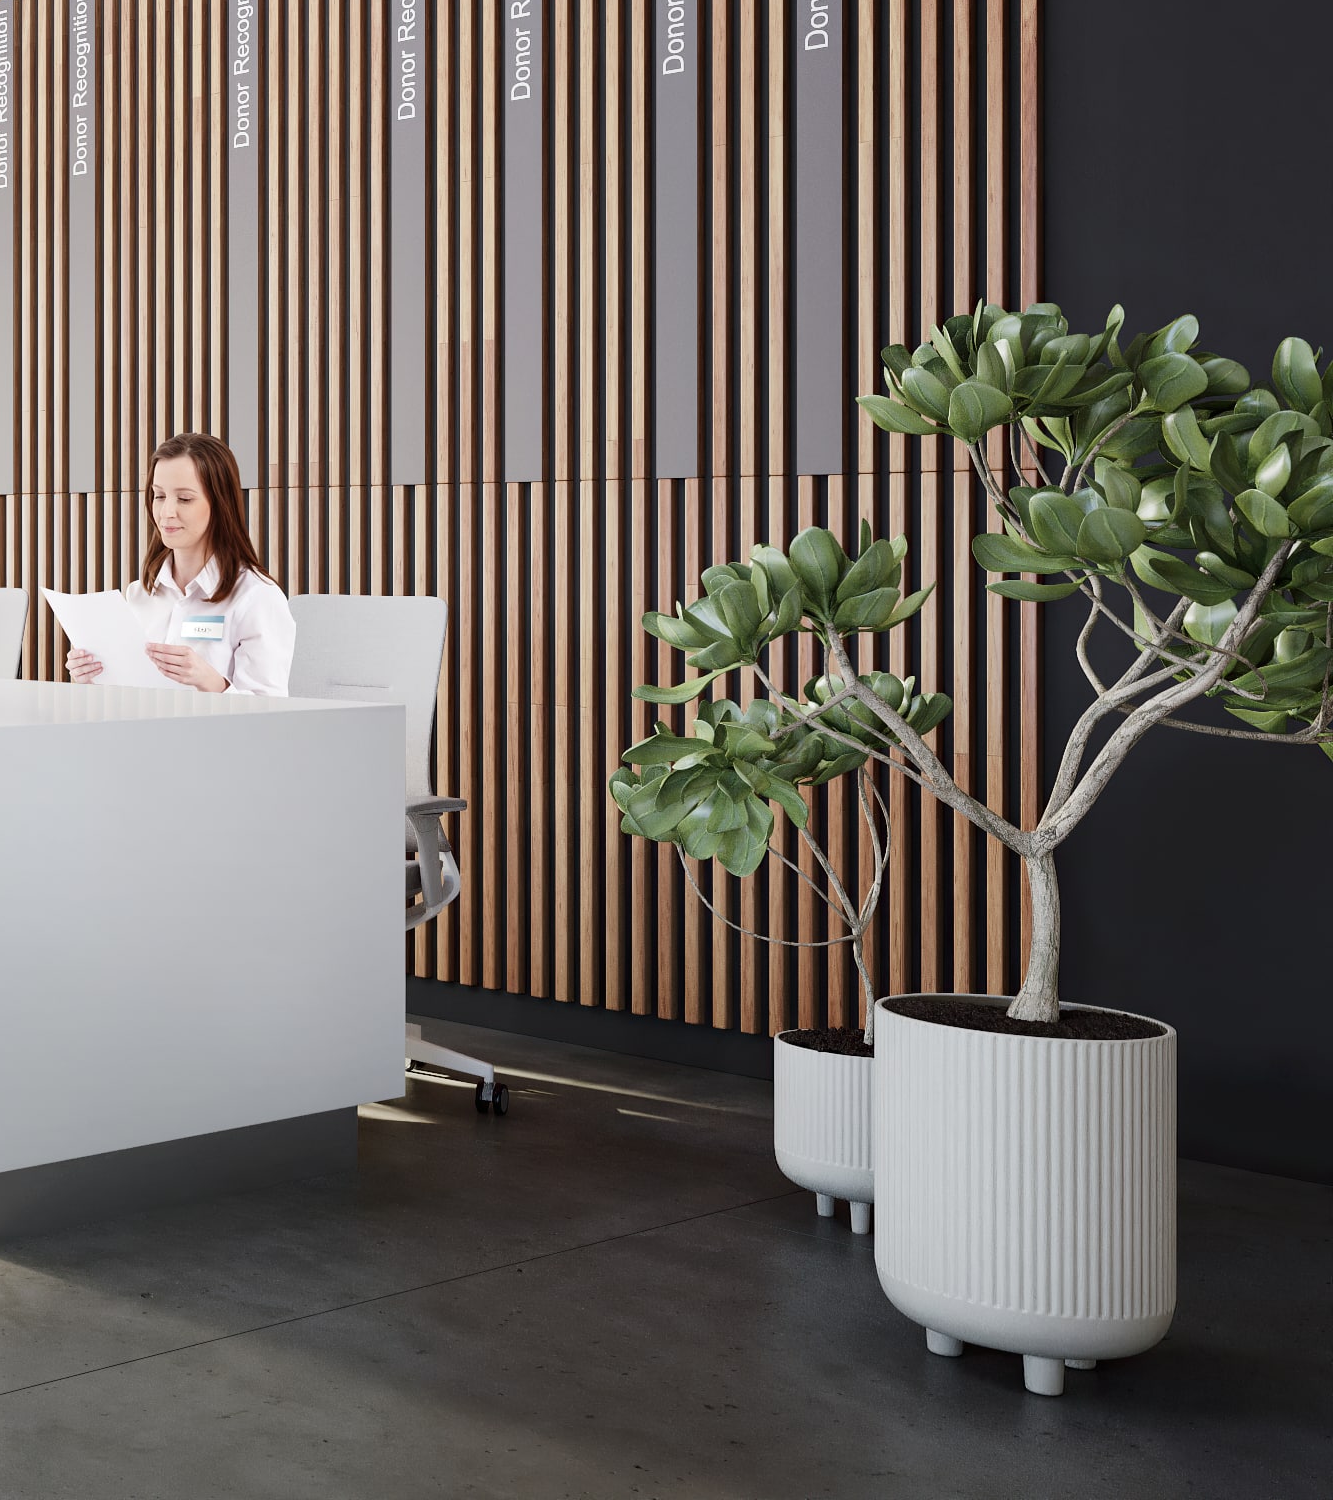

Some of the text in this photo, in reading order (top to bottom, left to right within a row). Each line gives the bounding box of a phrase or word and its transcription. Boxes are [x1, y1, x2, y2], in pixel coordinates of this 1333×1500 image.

[397, 50, 416, 120] Donor
[510, 27, 531, 100] Donor
[73, 114, 88, 175] Donor
[233, 82, 250, 148] Donor
